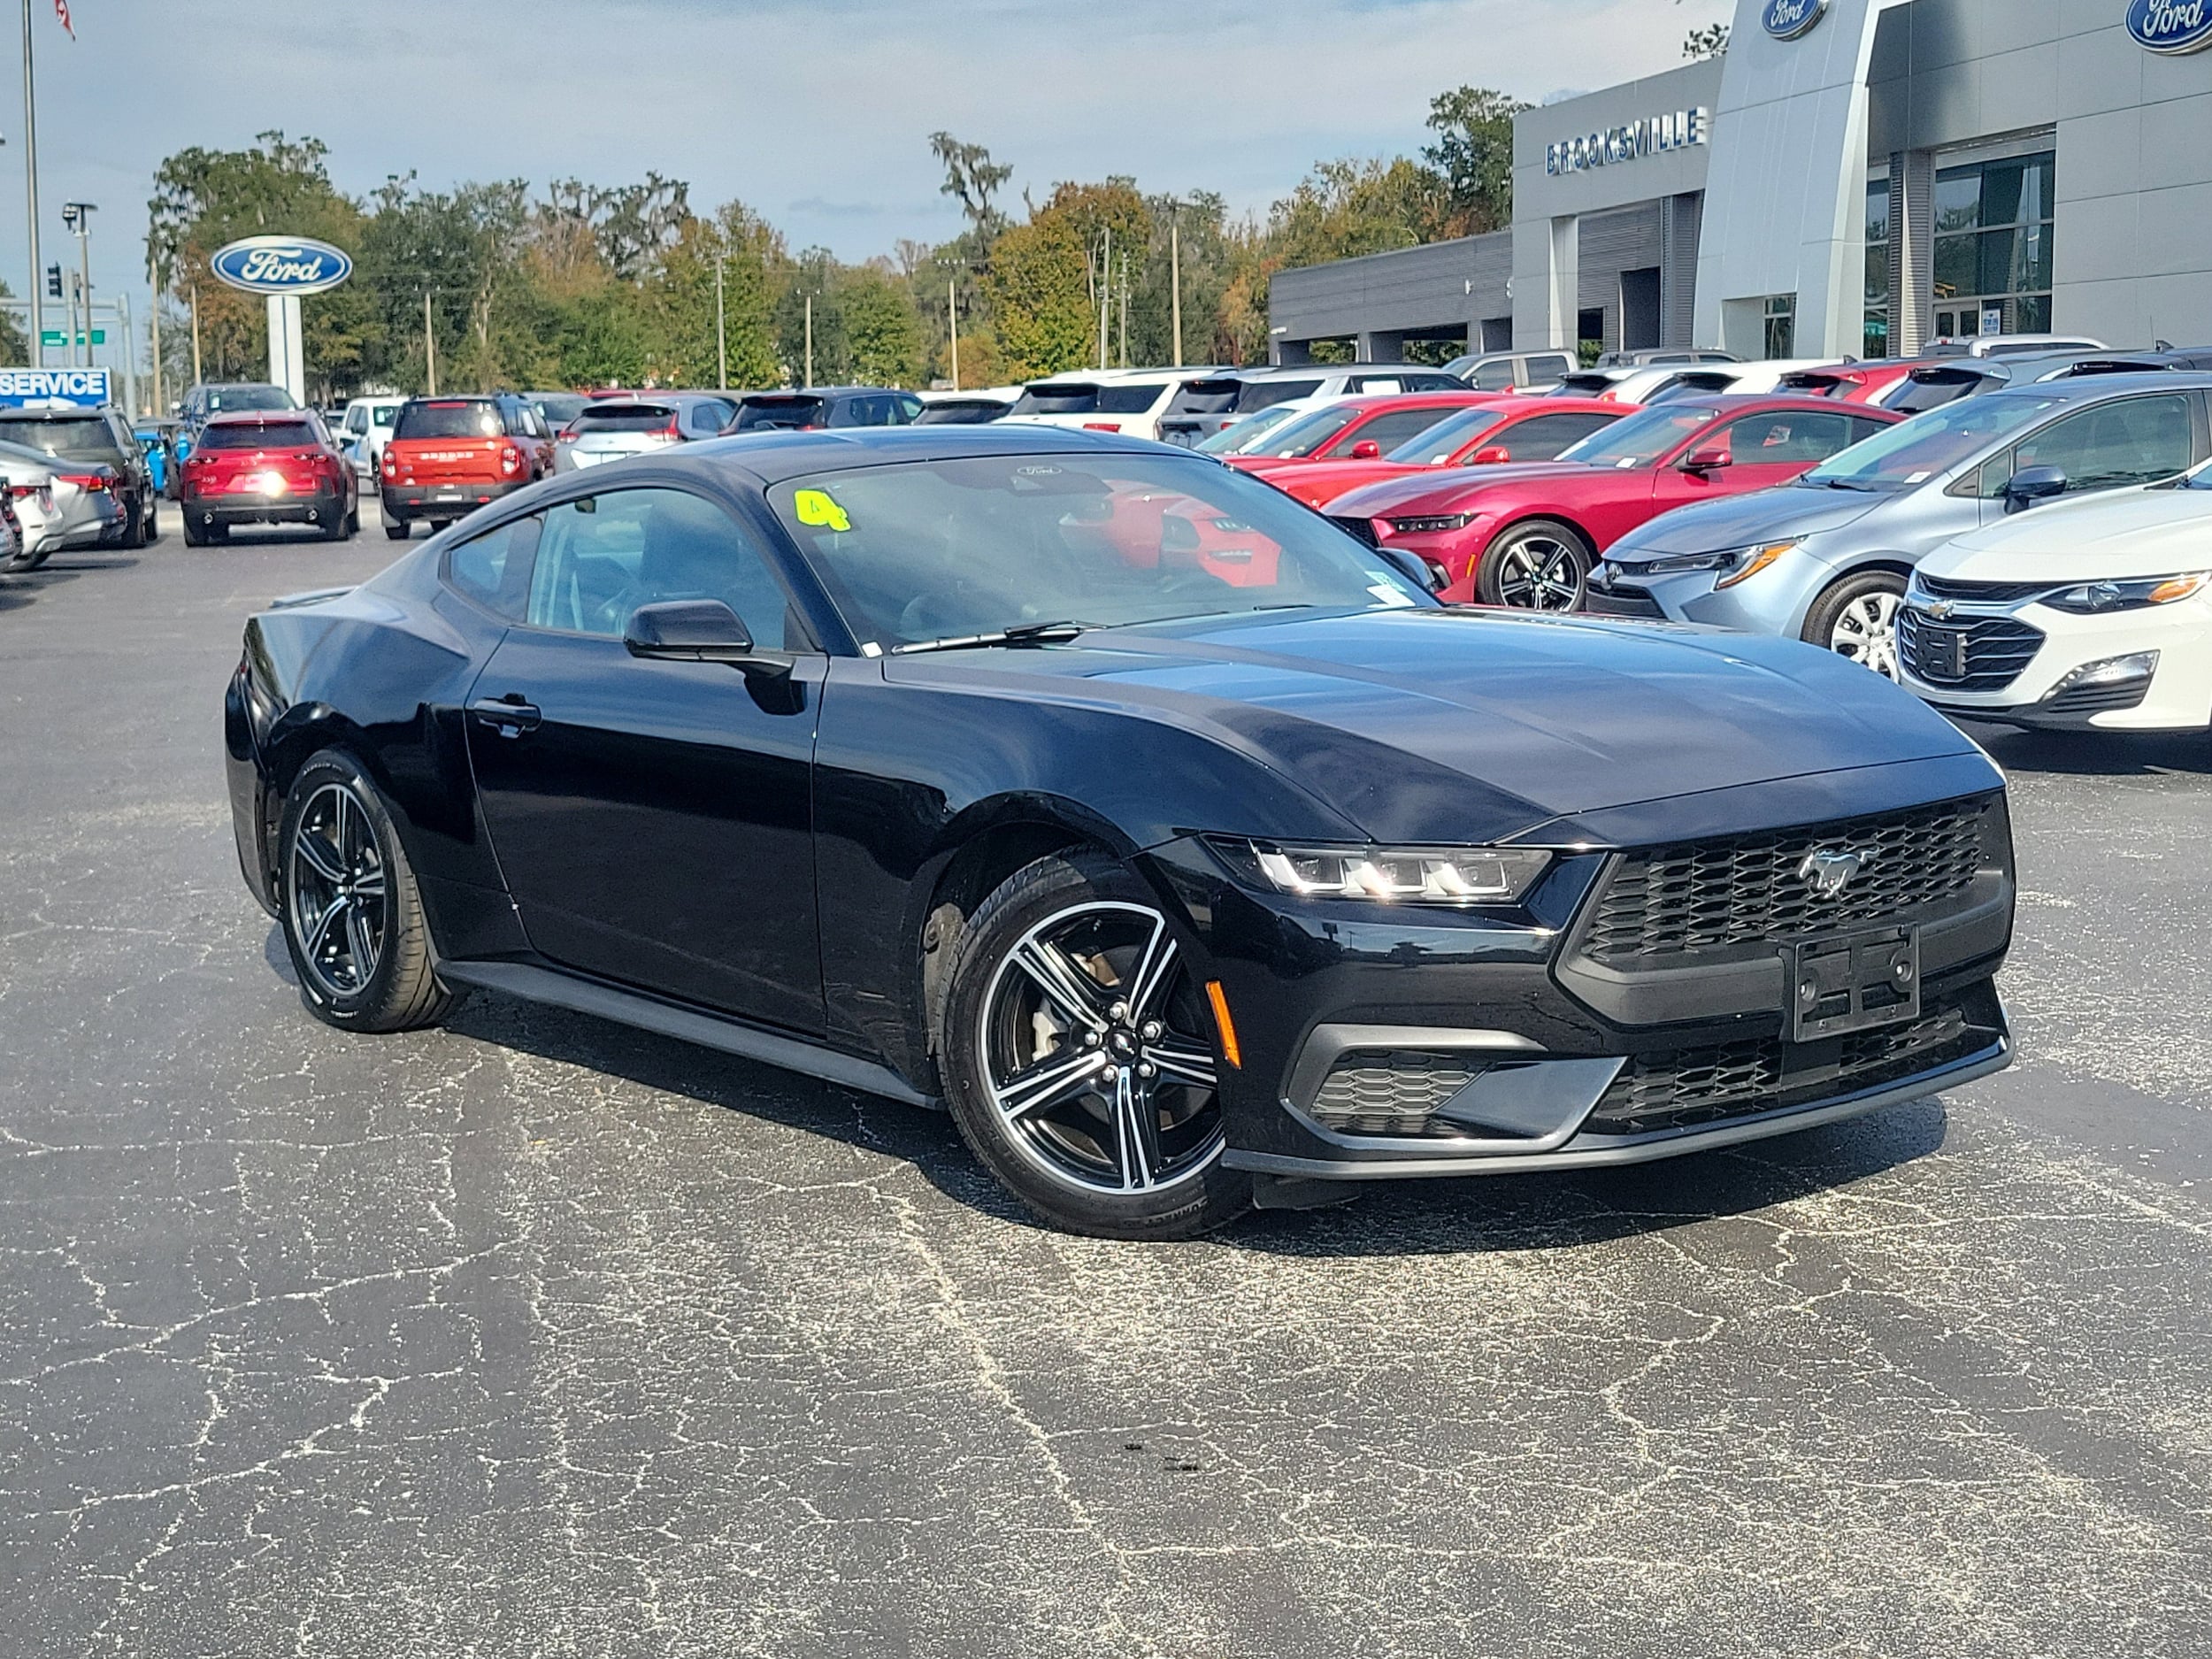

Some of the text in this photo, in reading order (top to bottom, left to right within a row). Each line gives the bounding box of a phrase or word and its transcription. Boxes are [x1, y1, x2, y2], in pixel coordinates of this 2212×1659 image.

[1770, 0, 1803, 27] Ford
[2143, 0, 2203, 37] Ford
[1545, 106, 1708, 176] BROOKSVILLE
[241, 248, 322, 281] Ford
[0, 373, 104, 396] SERVICE
